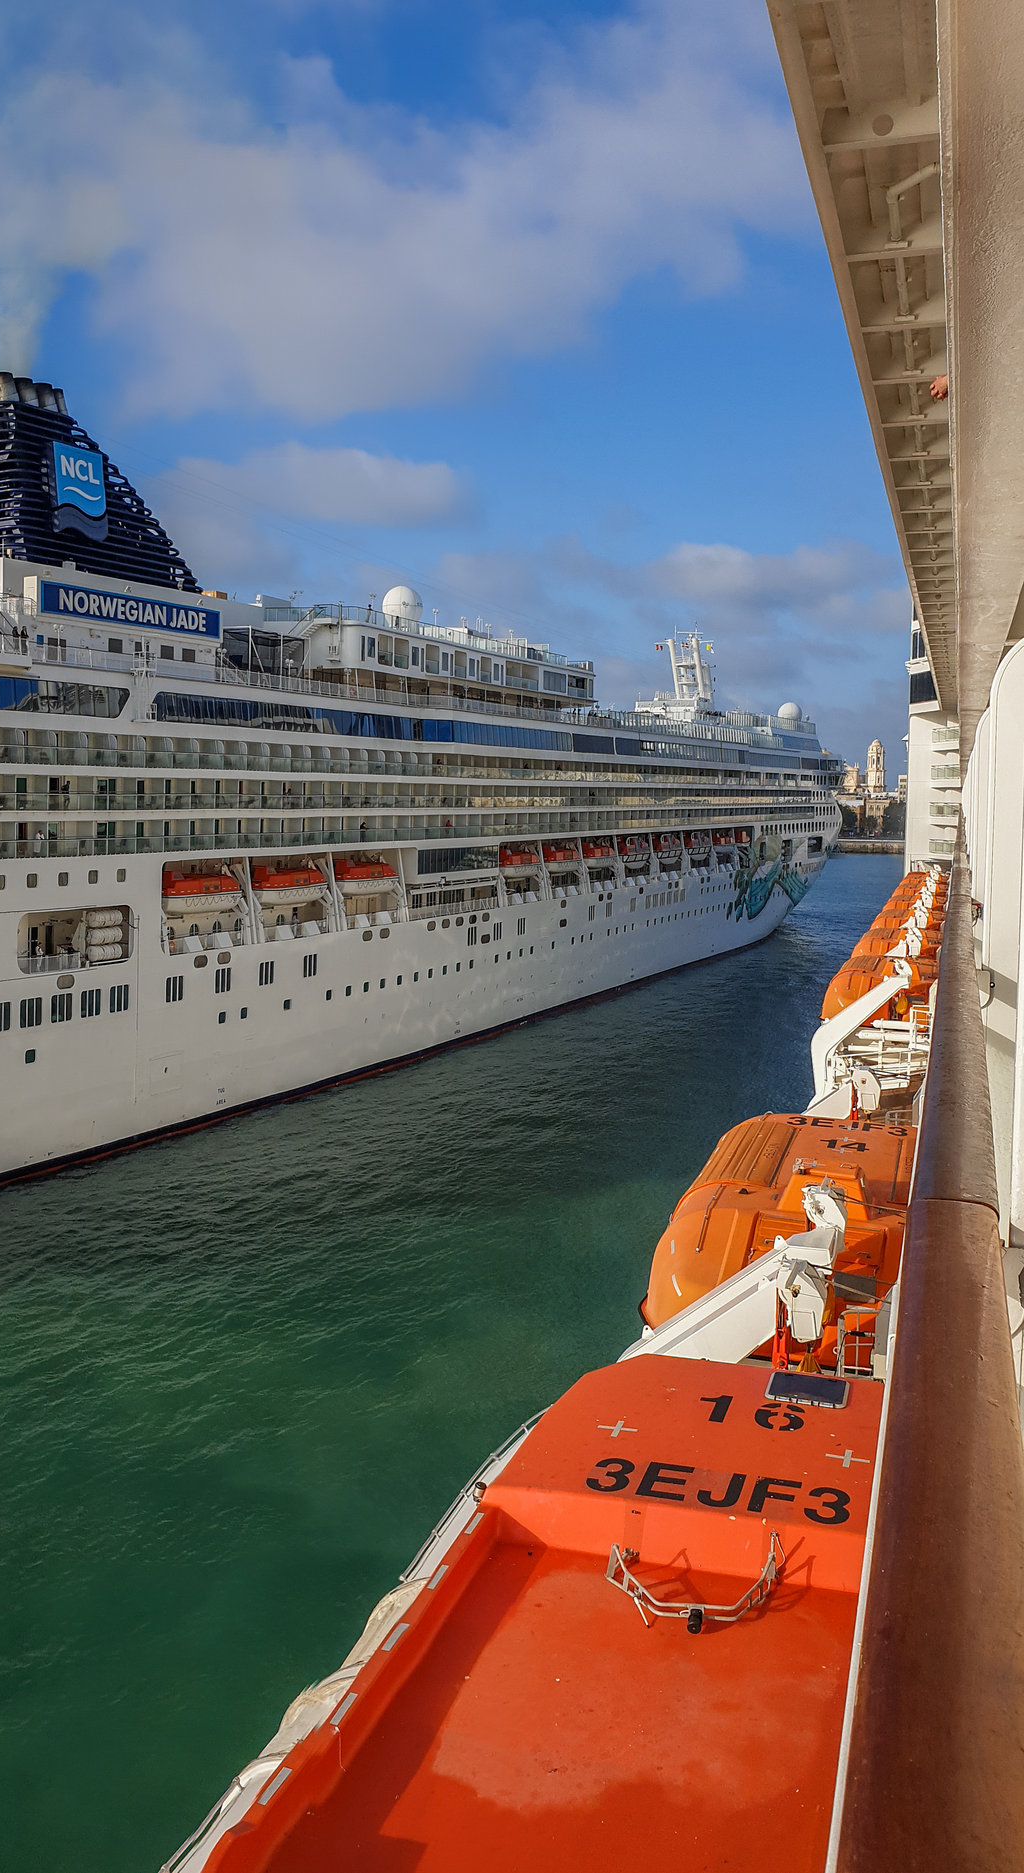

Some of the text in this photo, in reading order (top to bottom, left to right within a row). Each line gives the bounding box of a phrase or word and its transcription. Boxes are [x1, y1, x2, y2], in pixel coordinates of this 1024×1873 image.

[60, 454, 101, 485] NCL
[58, 588, 207, 632] NORWEGIAN JADE
[786, 1116, 908, 1137] 3EJF3
[820, 1139, 869, 1152] 14
[699, 1394, 805, 1431] 16
[585, 1457, 851, 1525] 3EJF3
